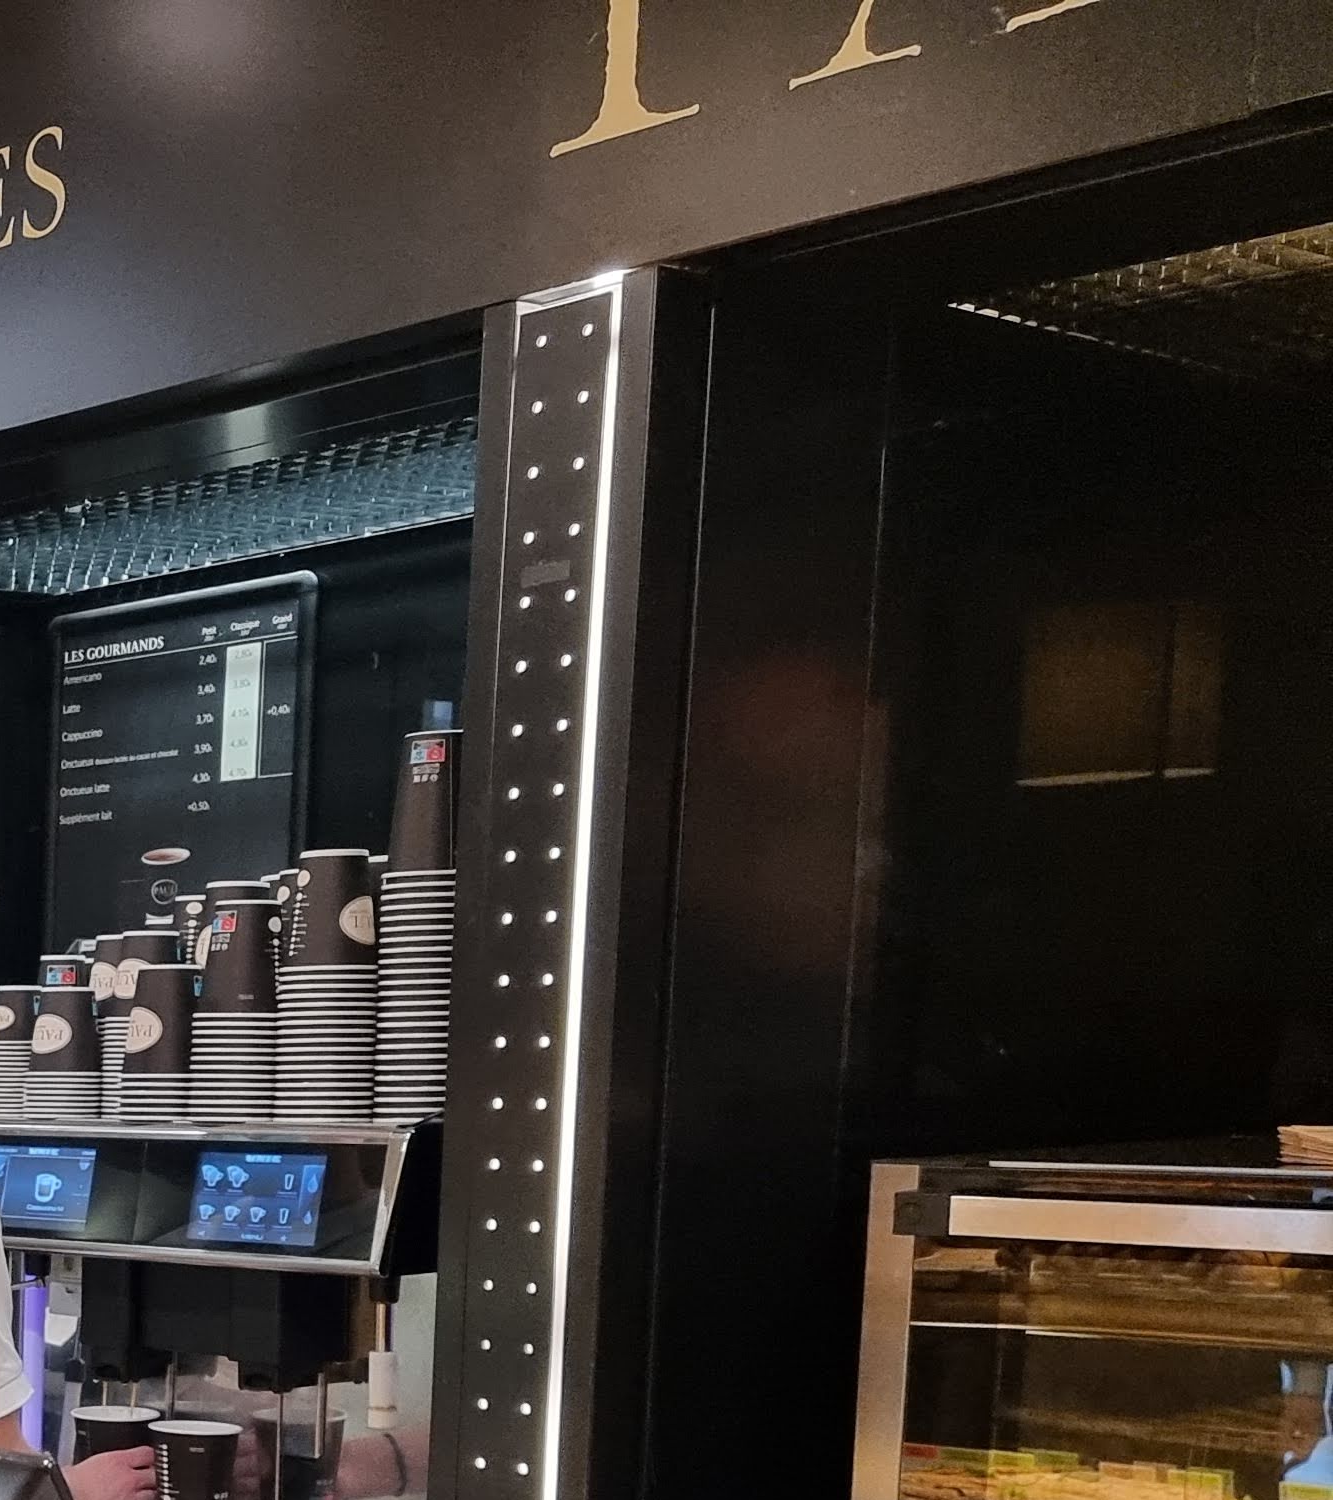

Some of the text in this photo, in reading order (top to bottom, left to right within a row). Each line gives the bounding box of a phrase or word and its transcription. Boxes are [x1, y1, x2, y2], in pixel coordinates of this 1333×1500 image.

[64, 636, 165, 664] LES GOURMANDS
[63, 672, 102, 686] Americano
[62, 704, 81, 715] Latte
[61, 729, 103, 742] Cappuccino
[59, 811, 100, 825] Supplément
[34, 1029, 63, 1041] PAU
